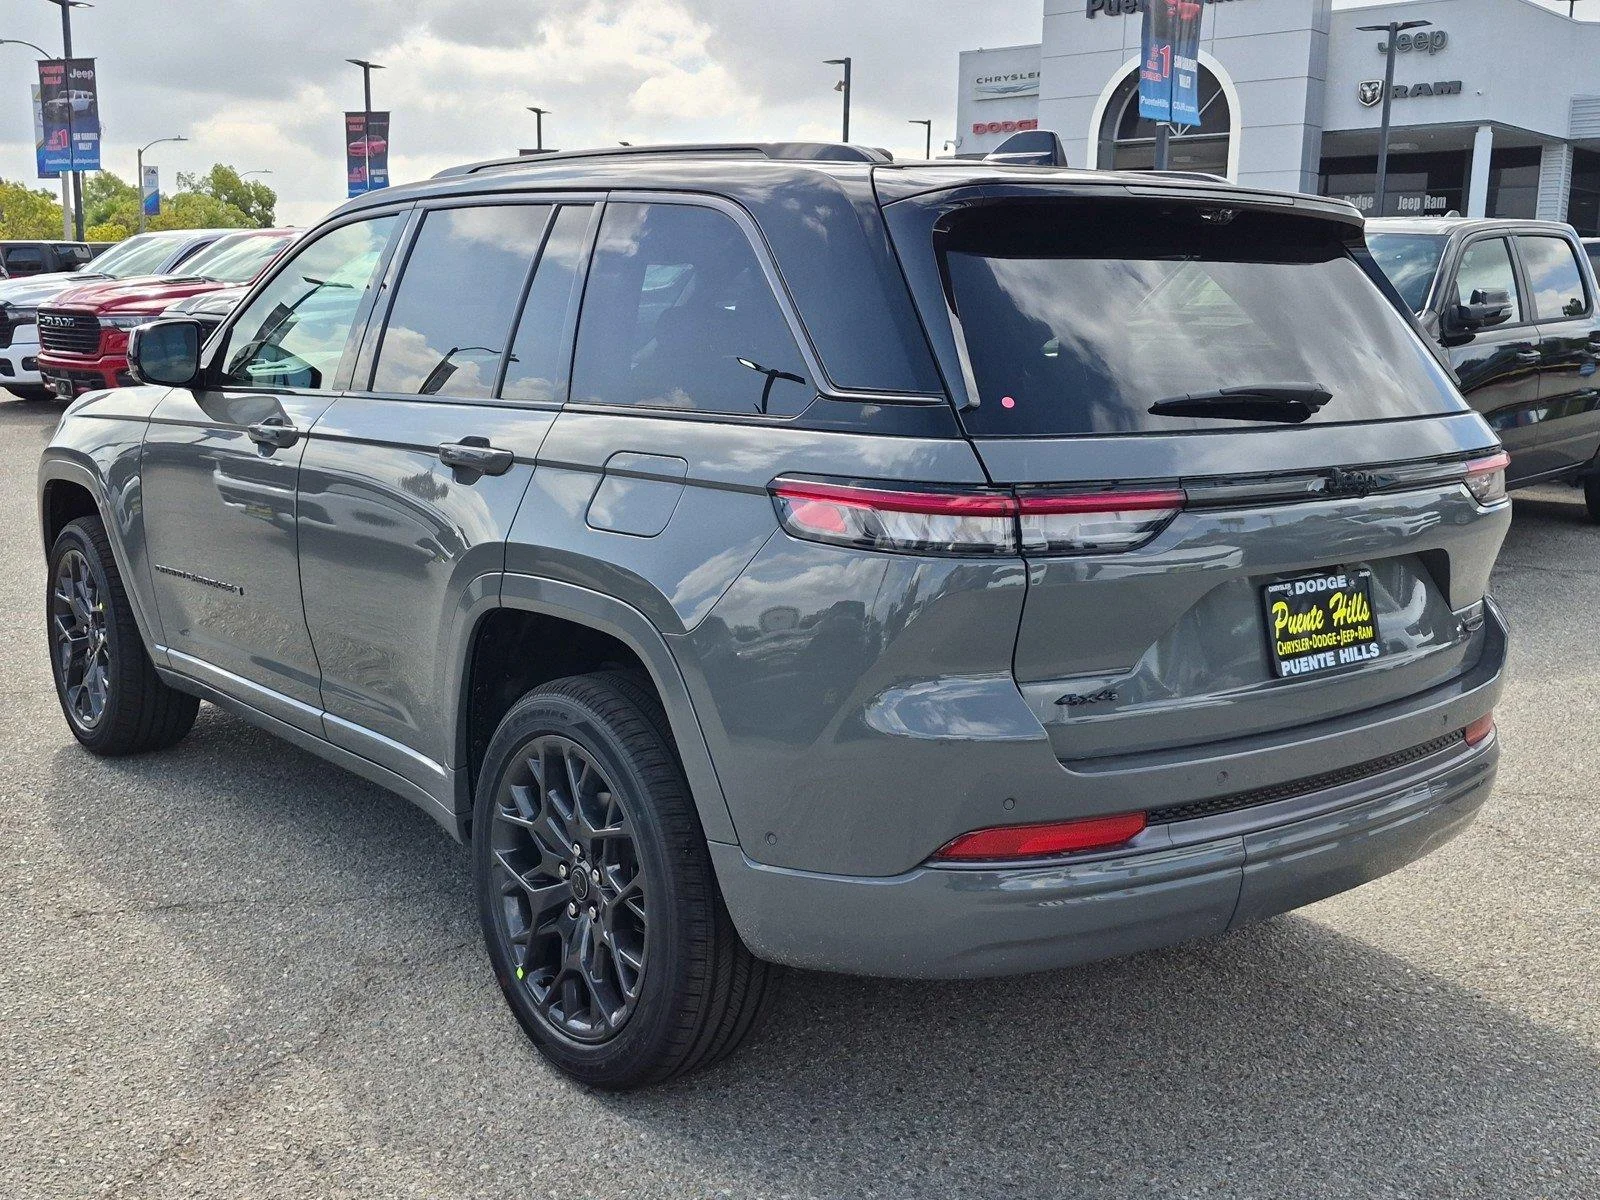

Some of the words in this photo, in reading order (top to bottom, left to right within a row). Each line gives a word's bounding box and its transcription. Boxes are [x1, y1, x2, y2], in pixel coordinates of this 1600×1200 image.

[69, 68, 94, 80] Jeep
[1391, 80, 1462, 98] RAM
[973, 118, 1038, 134] DODGE
[1397, 195, 1421, 211] Jeep
[1424, 194, 1447, 210] Ram
[1295, 575, 1347, 595] DODGE
[1271, 601, 1325, 639] Puente
[1329, 591, 1370, 627] Hills
[1280, 651, 1336, 676] PUENTE
[1339, 642, 1380, 664] HILLS
